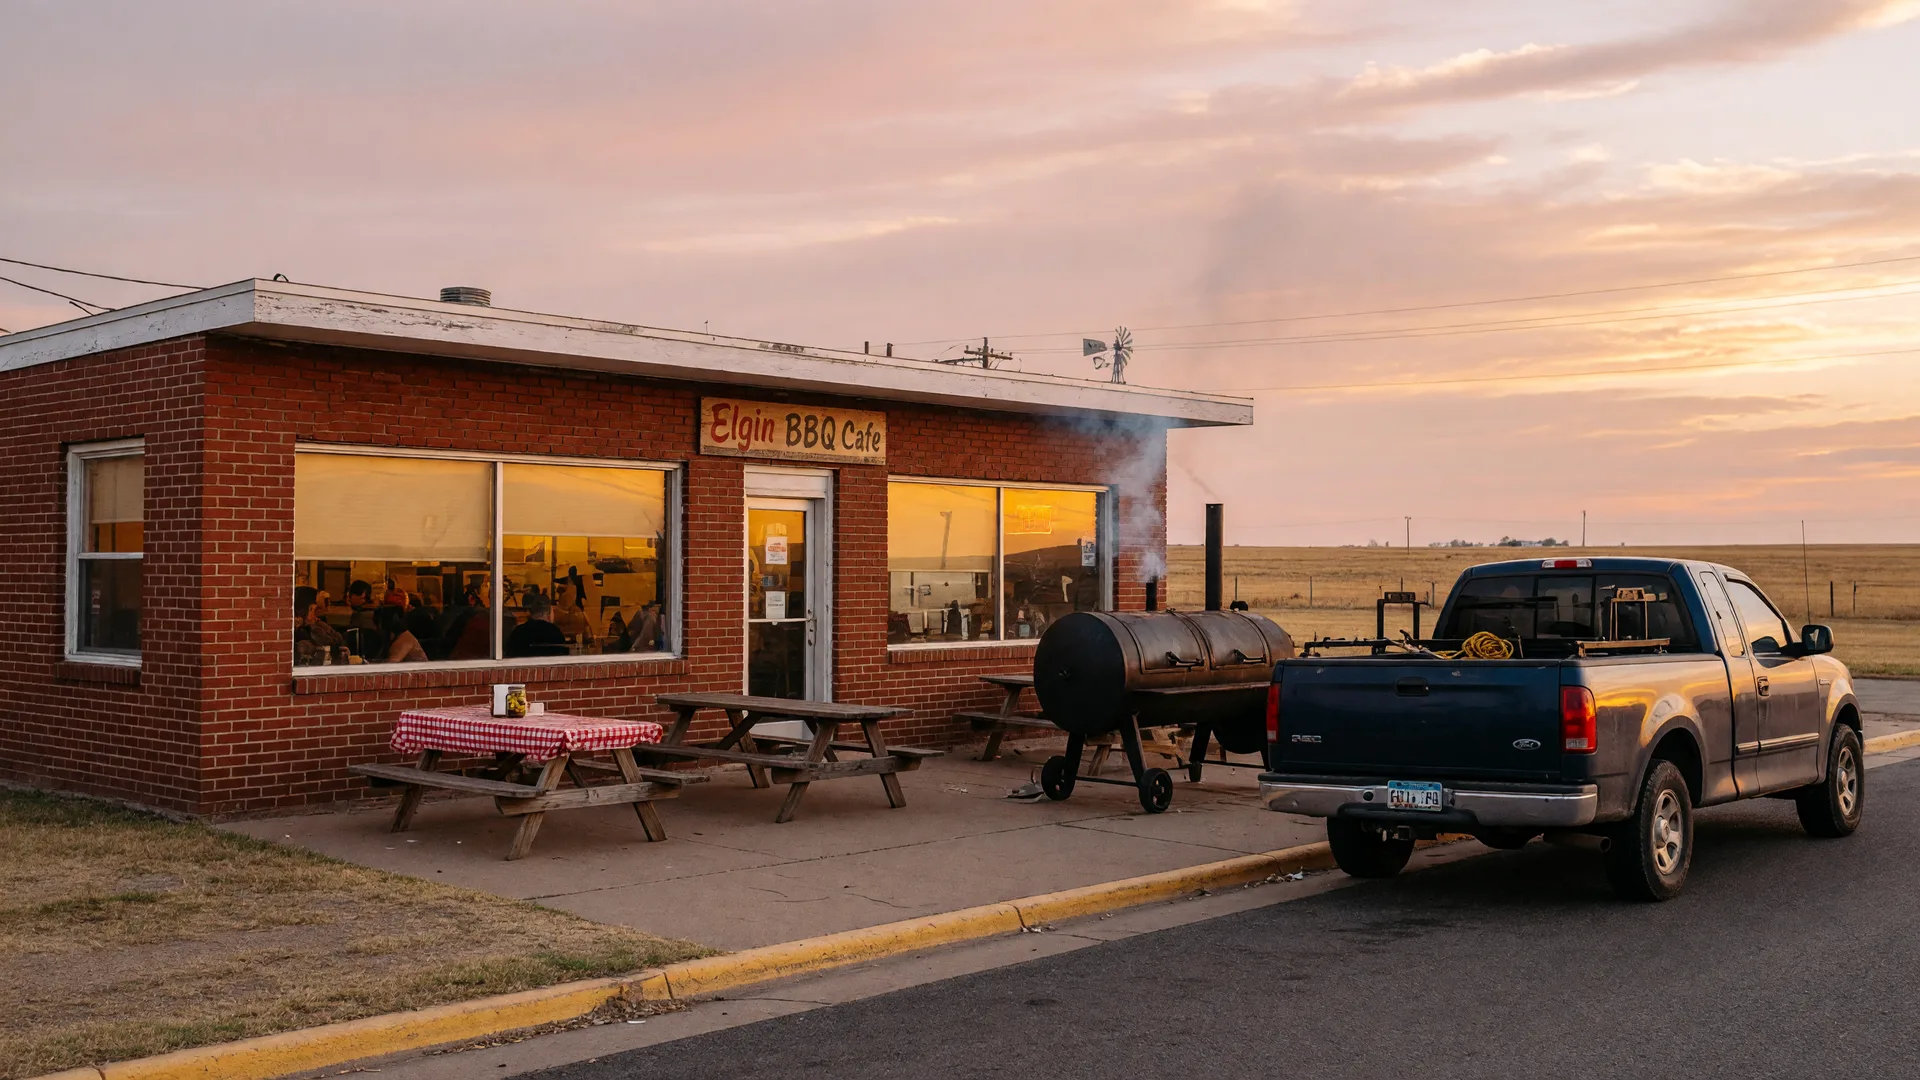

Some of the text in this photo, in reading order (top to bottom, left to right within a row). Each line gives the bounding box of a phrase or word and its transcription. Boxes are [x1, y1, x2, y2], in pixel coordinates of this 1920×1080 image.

[711, 403, 881, 452] Elgin BBQ Cafe
